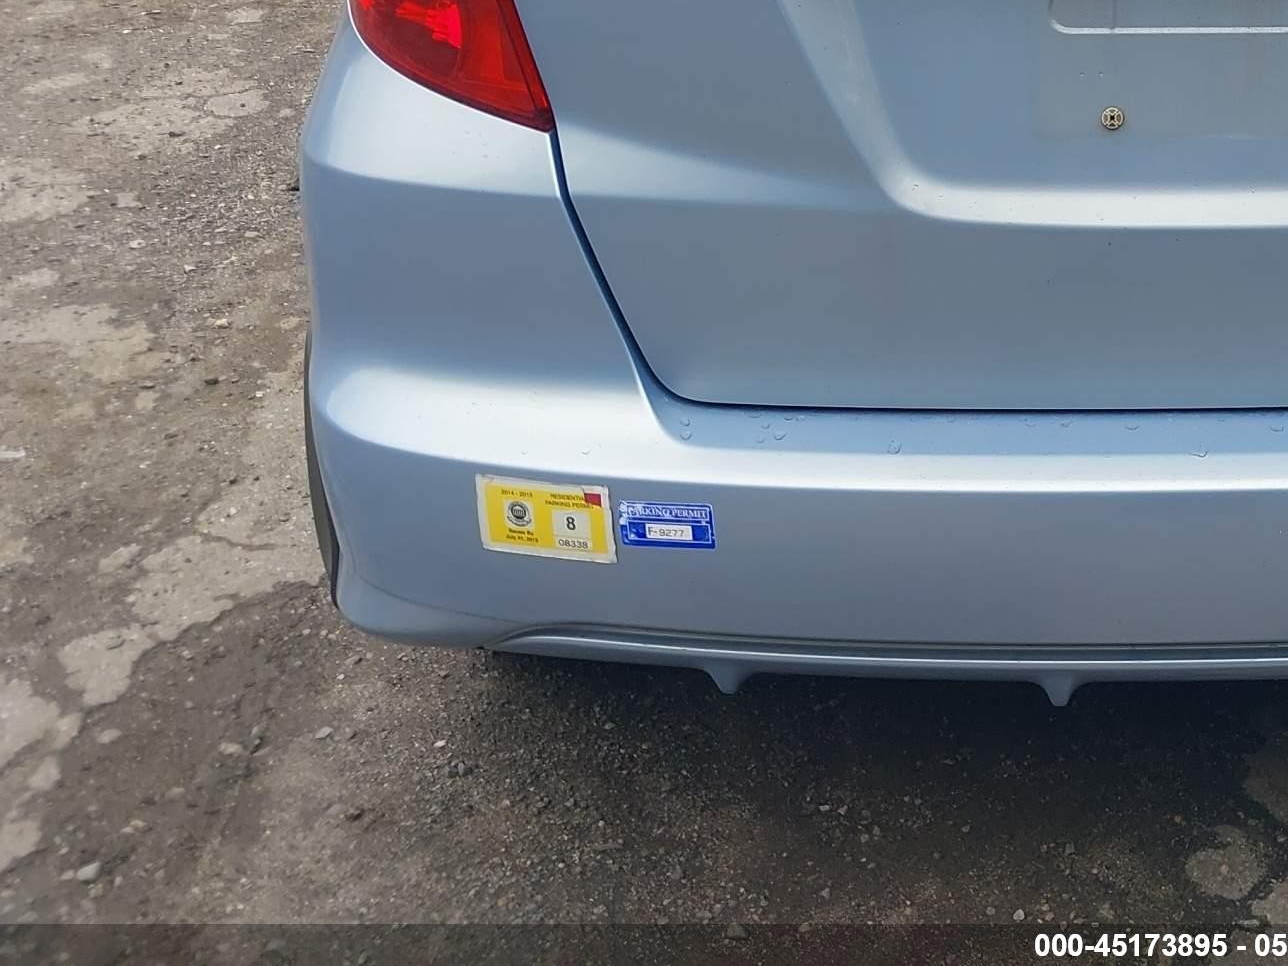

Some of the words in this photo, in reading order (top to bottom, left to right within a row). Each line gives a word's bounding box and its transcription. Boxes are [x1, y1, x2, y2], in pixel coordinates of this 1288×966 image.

[627, 505, 671, 517] PARKING
[671, 507, 707, 518] PERMIT
[565, 515, 577, 531] 8
[648, 526, 685, 538] F-9277
